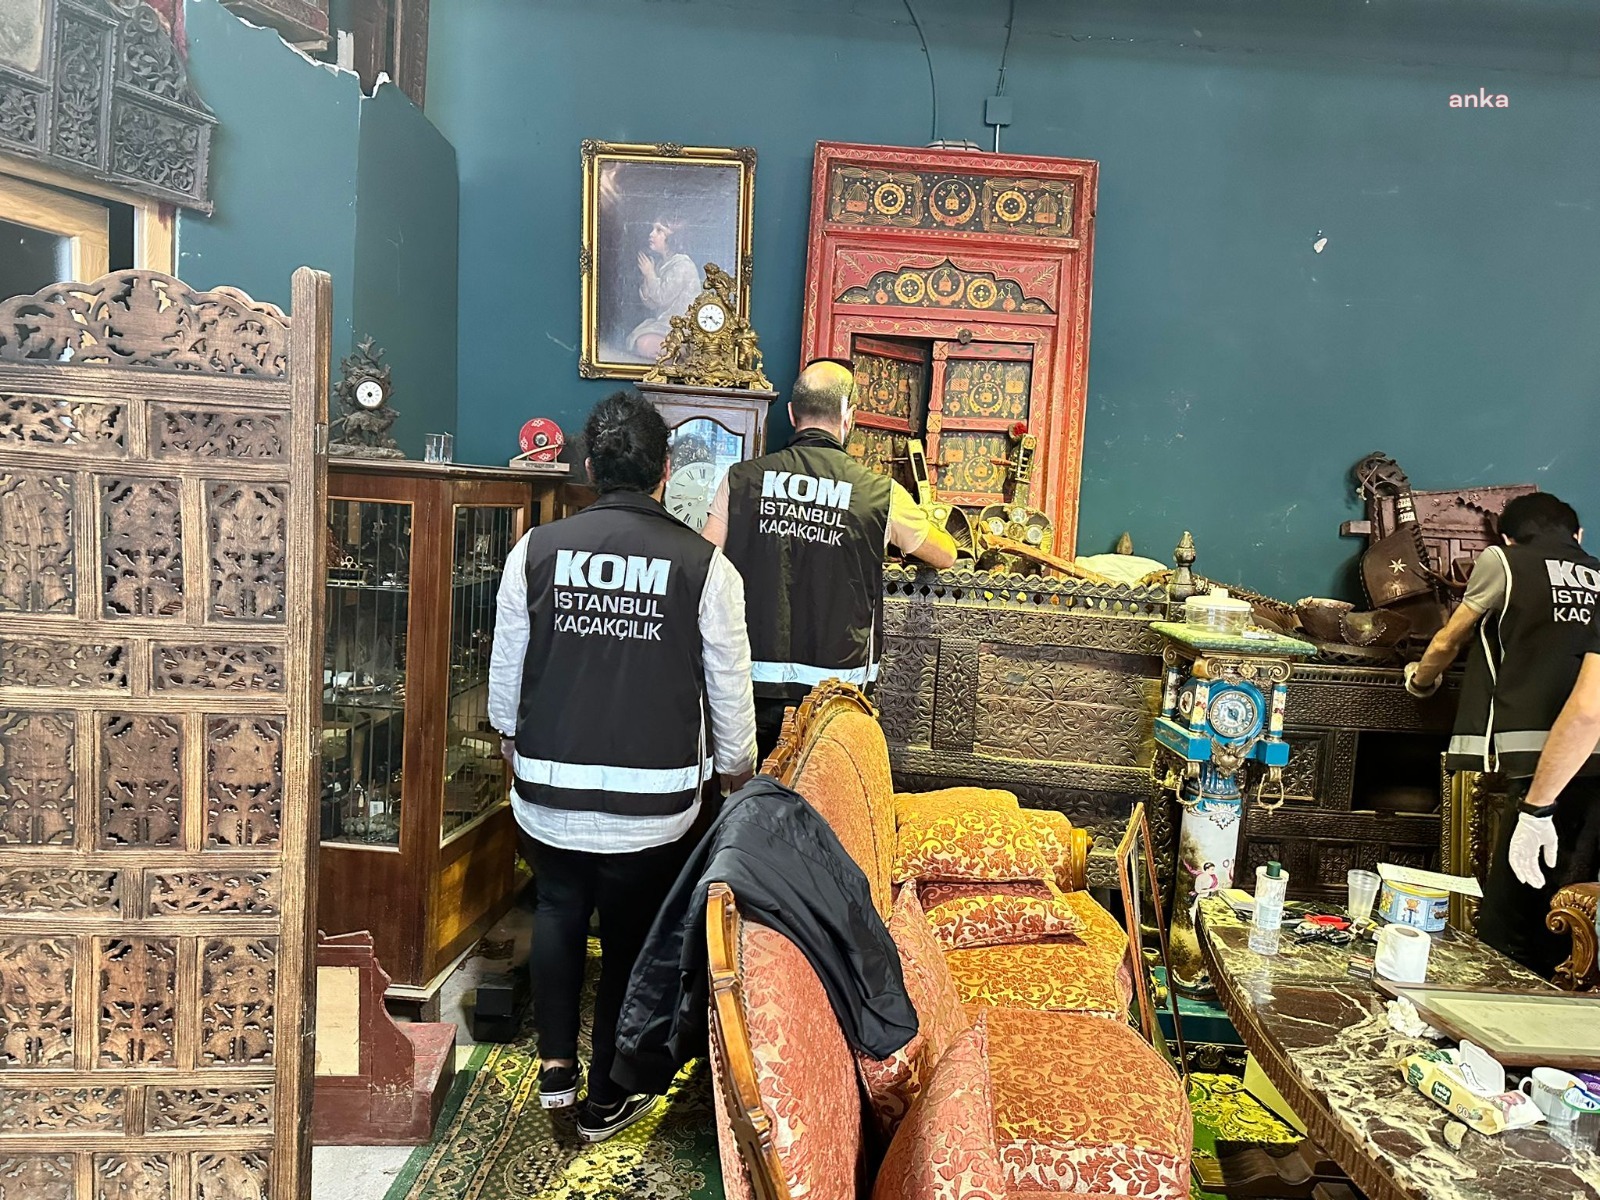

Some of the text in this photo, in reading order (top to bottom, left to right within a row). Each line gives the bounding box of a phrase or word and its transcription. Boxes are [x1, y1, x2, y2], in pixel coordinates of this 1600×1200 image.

[761, 470, 853, 511] KOM
[760, 498, 846, 529] İSTANBUL
[759, 519, 844, 546] KAÇAKÇILIK
[553, 549, 672, 596] KOM
[1545, 559, 1600, 592] KO
[553, 588, 664, 618] İSTANBUL
[1551, 587, 1597, 605] İSTA
[553, 613, 663, 641] KAÇAKÇILIK
[1553, 607, 1591, 625] KAÇ
